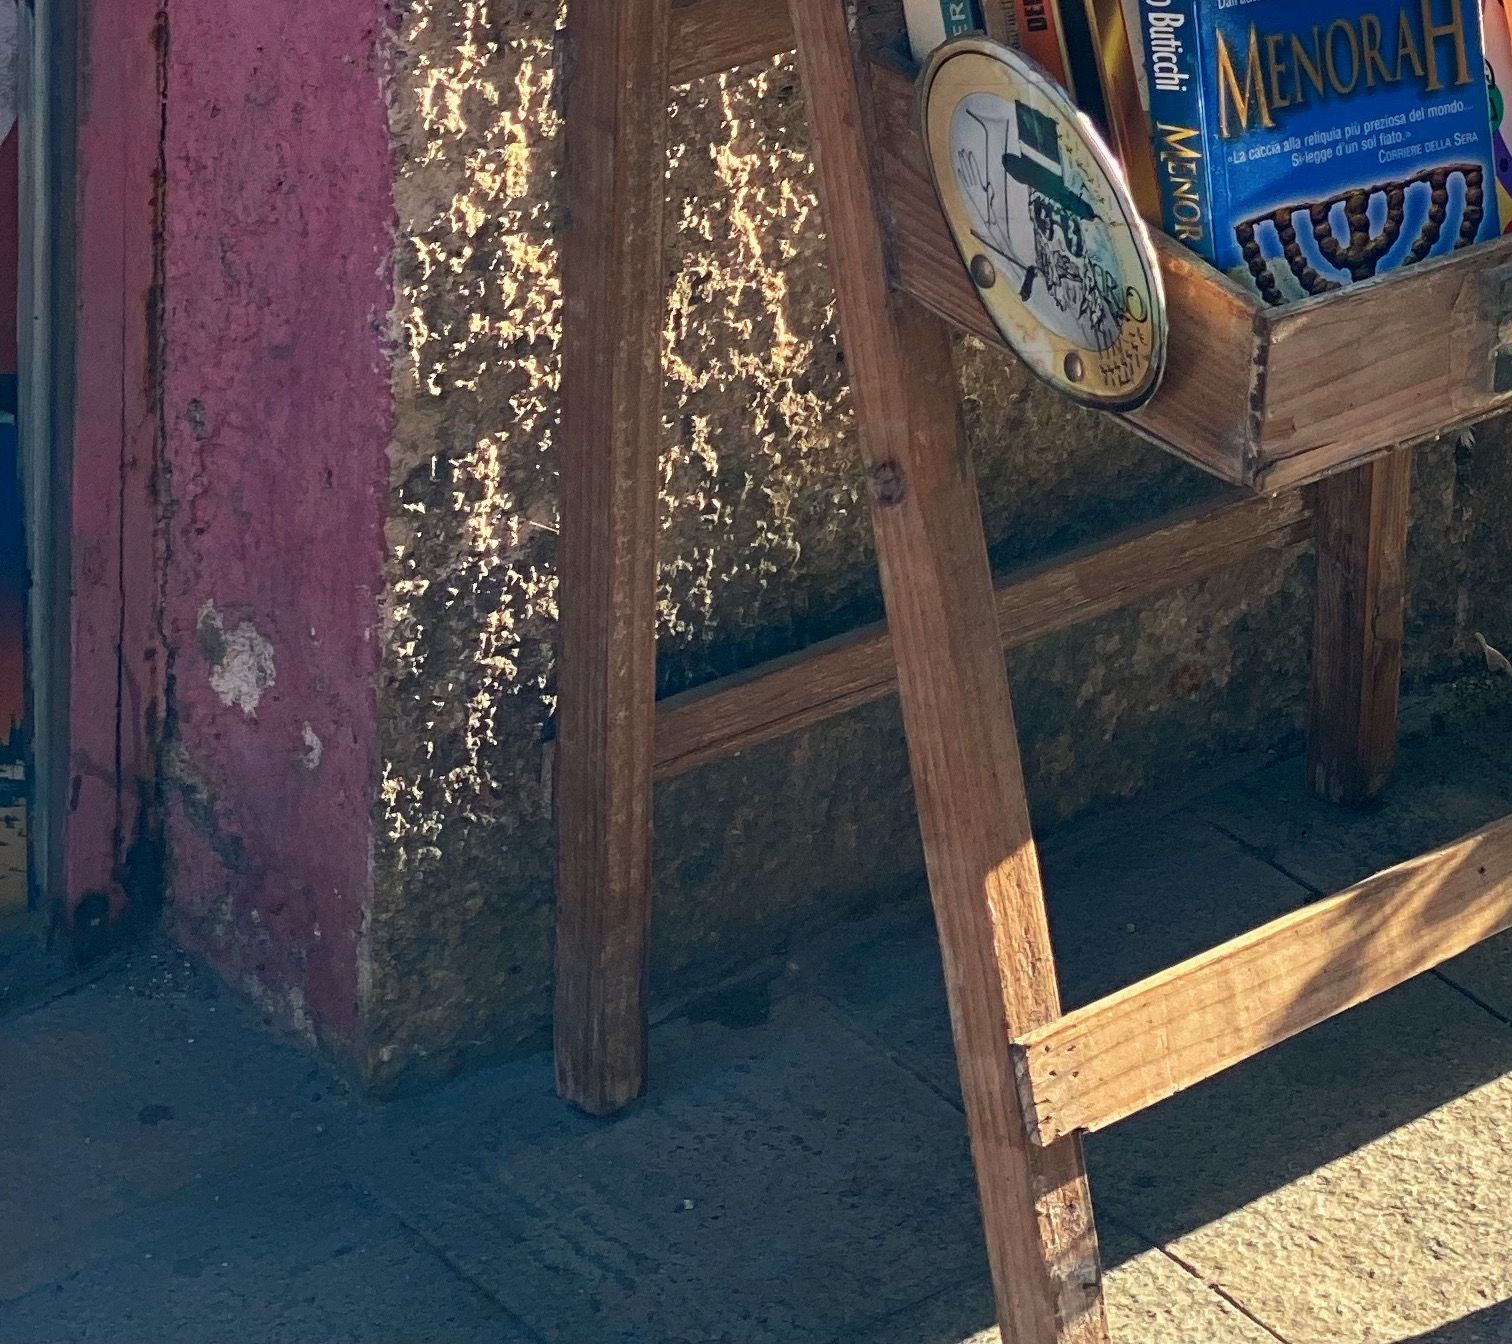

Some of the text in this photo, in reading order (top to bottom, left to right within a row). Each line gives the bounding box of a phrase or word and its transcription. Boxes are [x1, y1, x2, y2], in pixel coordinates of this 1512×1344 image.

[1144, 12, 1188, 93] Buticchi
[1248, 143, 1282, 161] caccia
[1282, 137, 1302, 154] alla
[1303, 129, 1343, 148] reliquia
[1344, 124, 1362, 143] più
[1362, 113, 1407, 139] preziosa
[1408, 108, 1427, 124] del
[1335, 141, 1359, 158] d'un
[1360, 138, 1378, 153] sol
